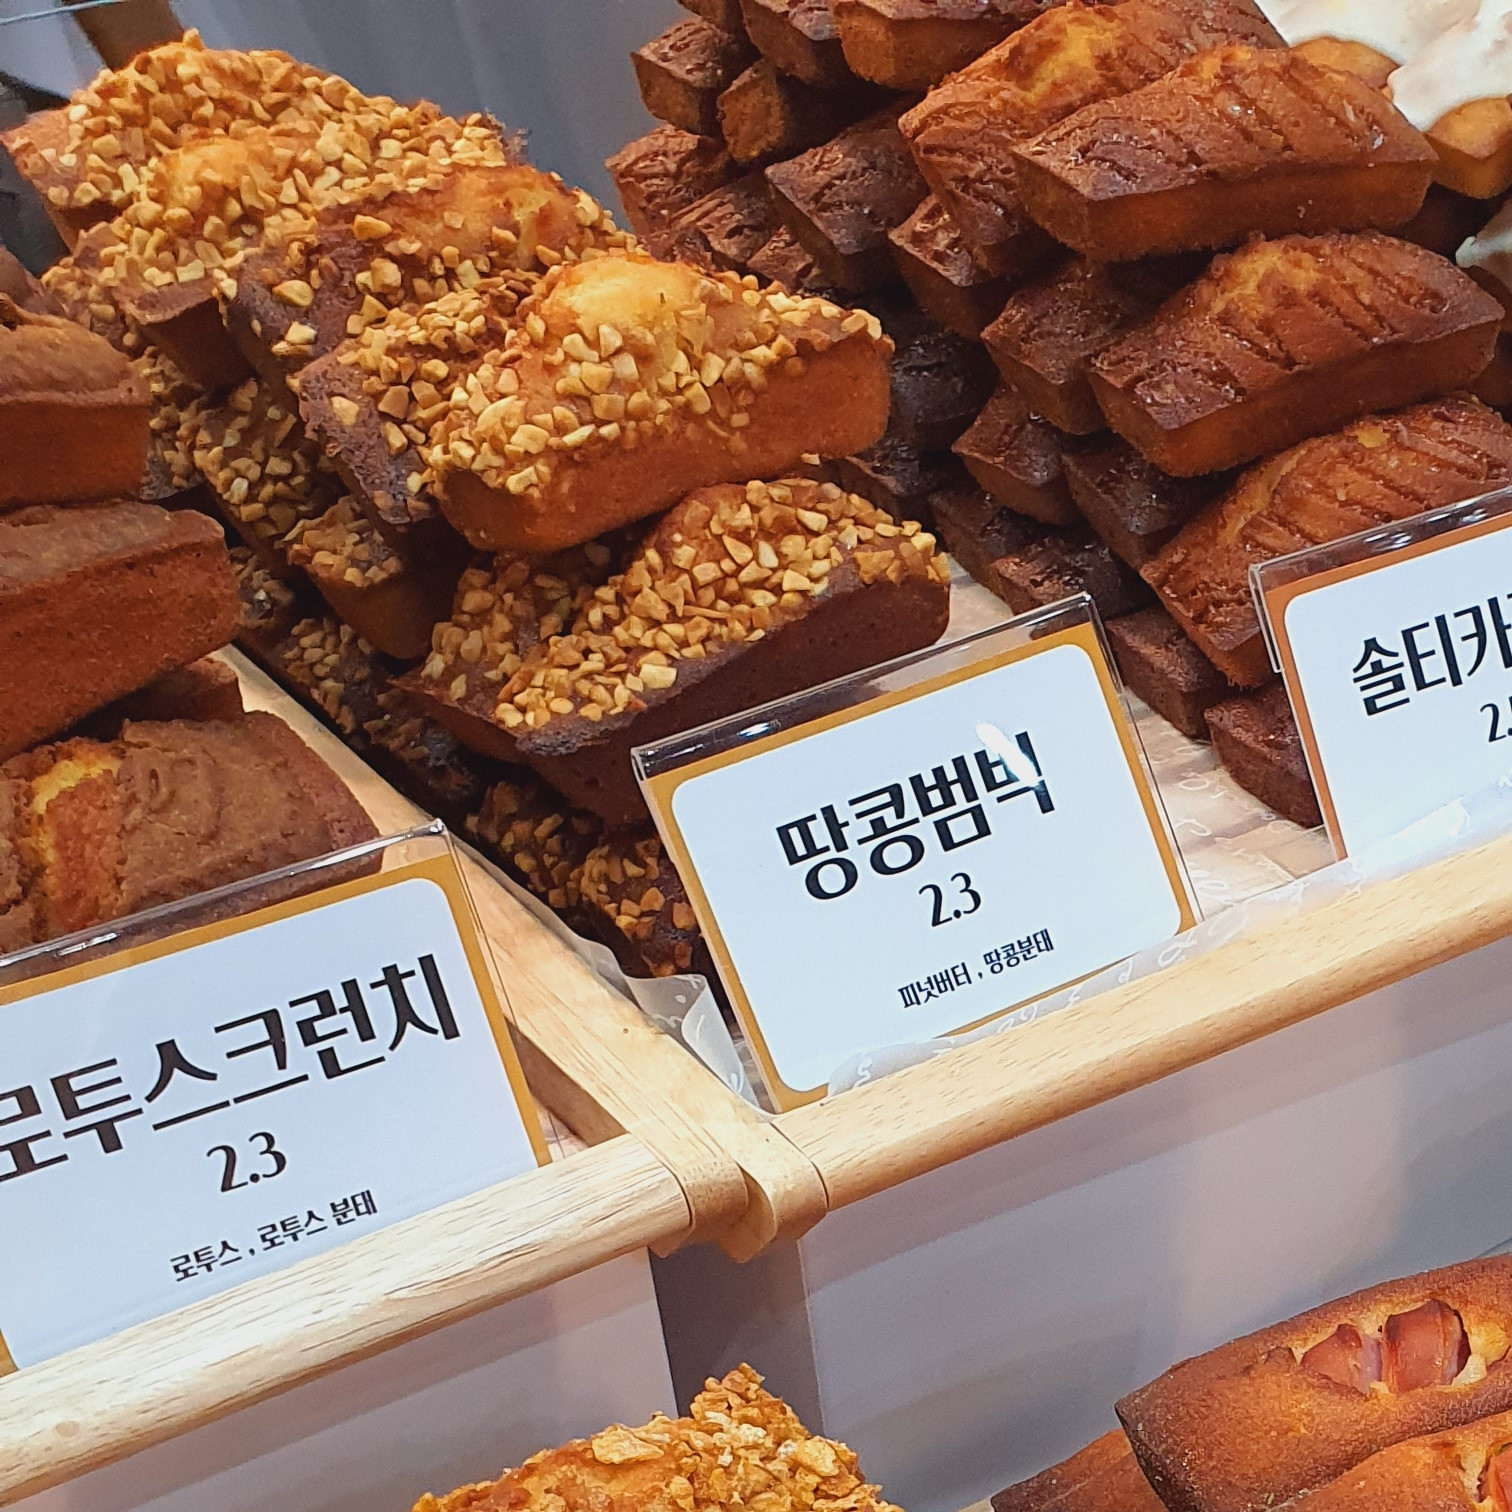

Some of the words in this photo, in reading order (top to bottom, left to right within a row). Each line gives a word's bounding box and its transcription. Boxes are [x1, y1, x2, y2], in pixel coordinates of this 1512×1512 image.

[918, 871, 982, 928] 2.3
[983, 928, 1054, 974] 땅콩분태
[0, 953, 461, 1183] 로투스크런치
[206, 1130, 288, 1193] 2.3
[259, 1209, 328, 1252] 로투스
[329, 1189, 378, 1226] 분태
